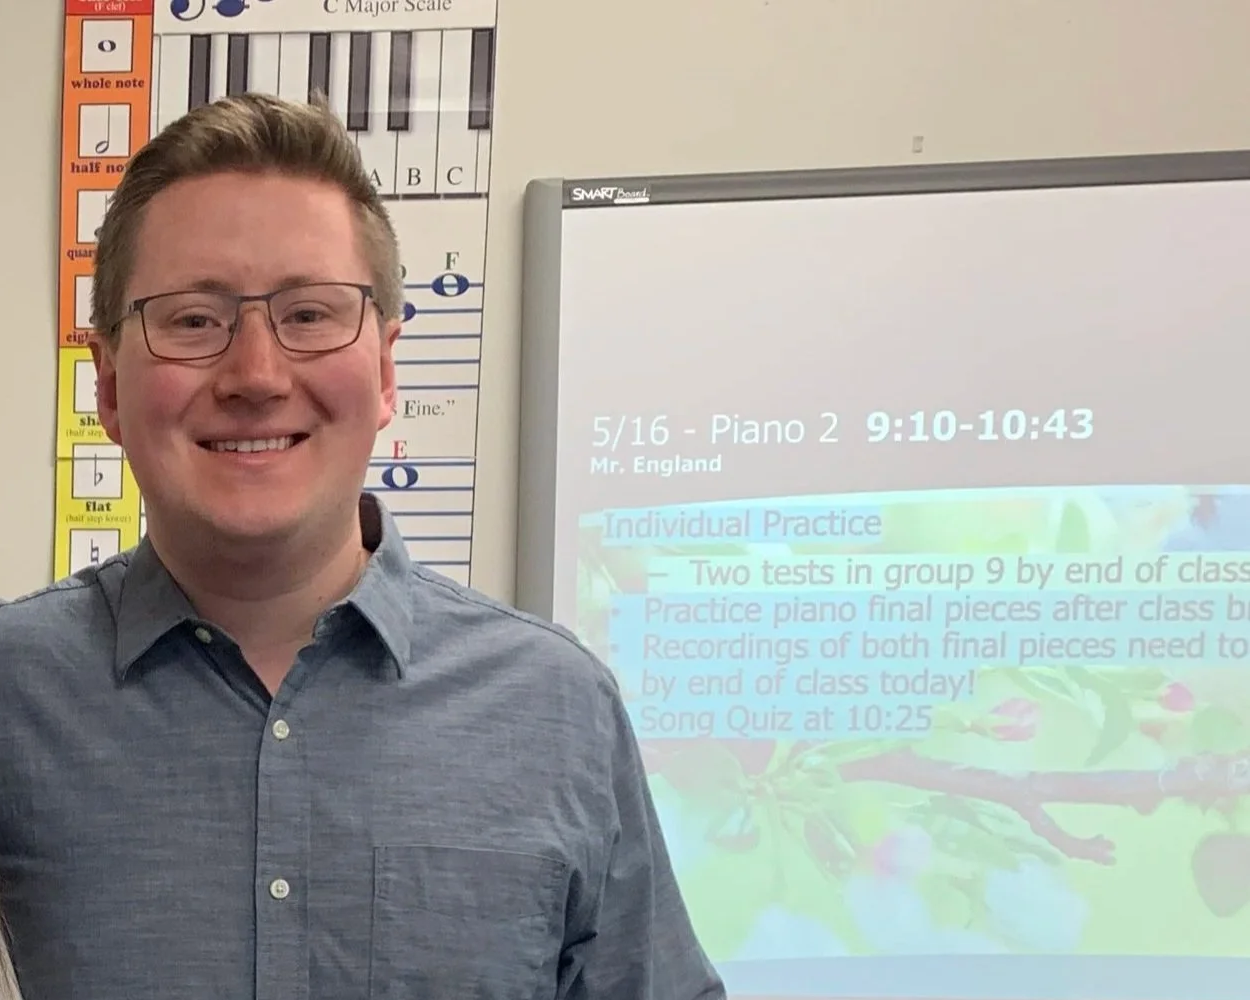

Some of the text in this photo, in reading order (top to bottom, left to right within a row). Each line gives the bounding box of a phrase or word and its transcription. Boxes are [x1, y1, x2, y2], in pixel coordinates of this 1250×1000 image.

[323, 0, 452, 17] C Major Scale
[71, 78, 145, 89] whole note
[70, 162, 125, 173] half no
[369, 166, 463, 187] A B C
[572, 187, 618, 201] SMART
[67, 249, 96, 260] quar
[445, 251, 460, 270] F
[591, 415, 670, 451] 5/16
[711, 414, 805, 444] Piano
[819, 412, 839, 443] 2
[866, 408, 1094, 442] 9:10-10:43
[392, 440, 408, 460] E
[590, 454, 722, 477] Mr. England
[86, 501, 111, 512] flat
[603, 508, 882, 538] Individual Practice
[689, 554, 1250, 590] Two tests in group 9 by end of class
[644, 597, 762, 623] Practice
[773, 596, 857, 628] piano
[868, 594, 932, 622] final
[945, 595, 1041, 628] pieces
[1052, 594, 1128, 622] after
[1138, 594, 1214, 621] class
[643, 631, 1249, 665] Recordings of both final pieces need to
[641, 668, 975, 701] by end of class today!
[640, 704, 932, 738] Song Quiz at 10:25
